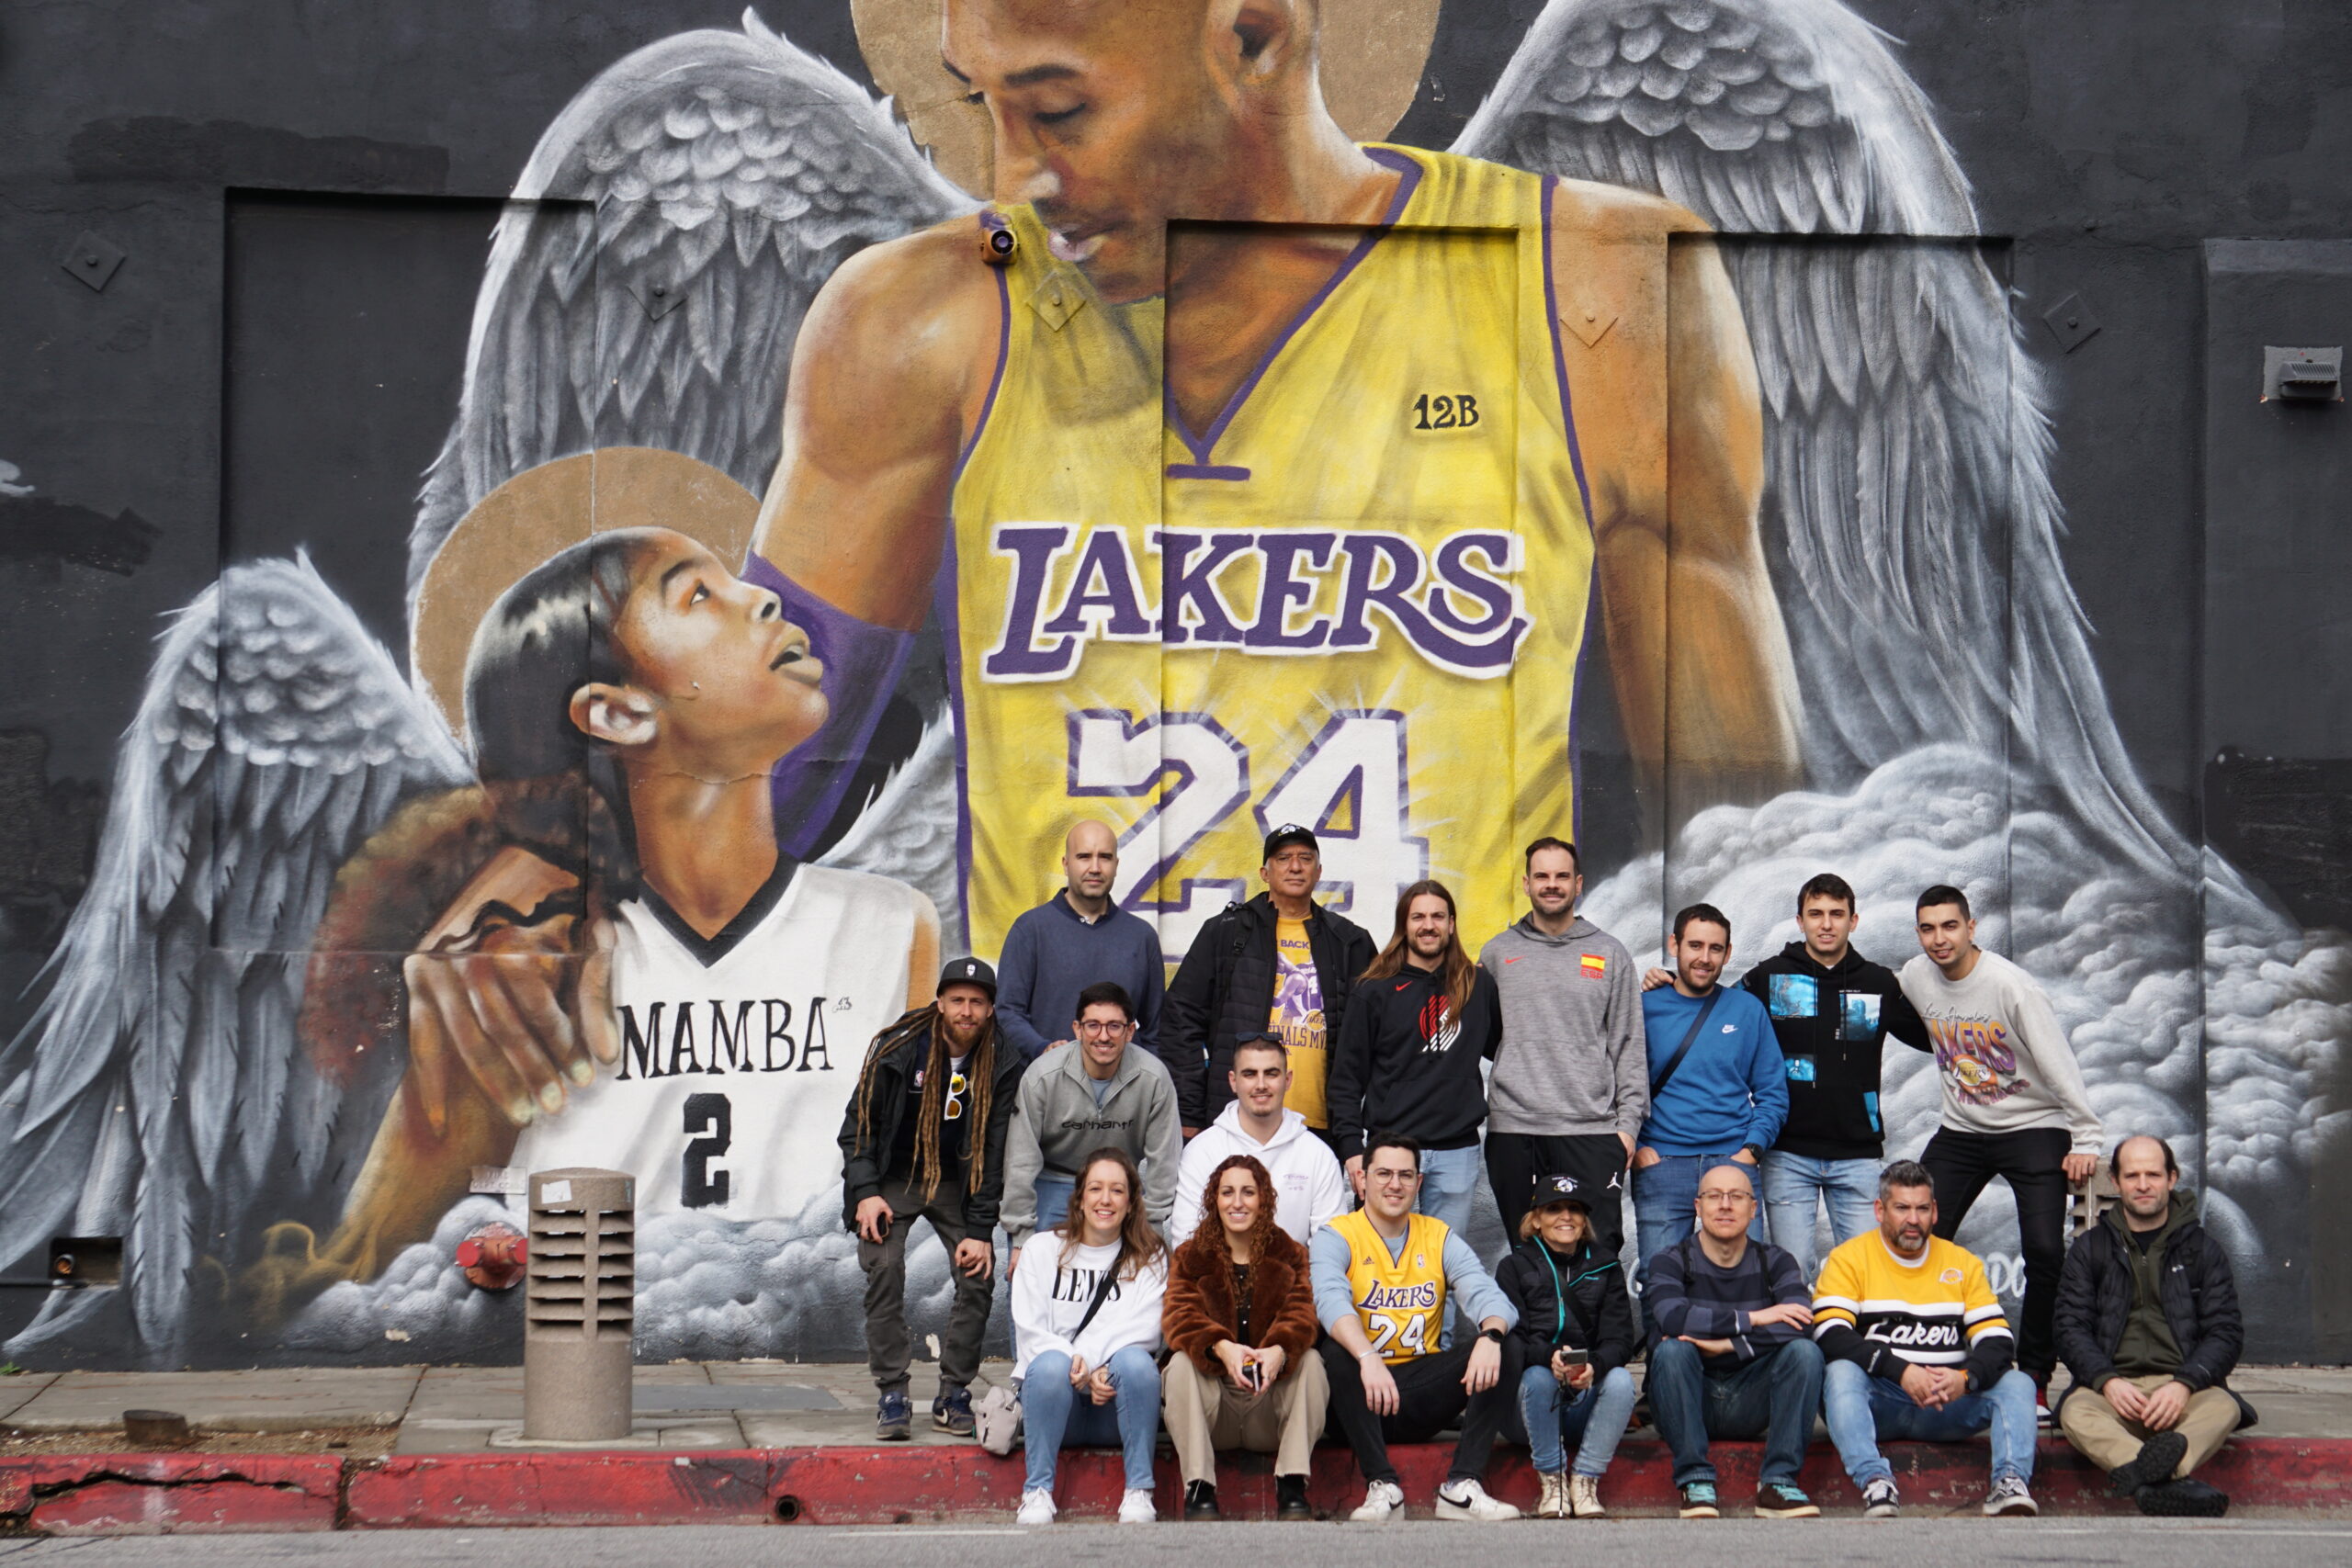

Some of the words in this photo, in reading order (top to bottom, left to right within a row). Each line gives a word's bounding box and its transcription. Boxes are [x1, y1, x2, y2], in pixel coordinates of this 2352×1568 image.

[1412, 393, 1479, 429] 12B
[982, 522, 1534, 682] LAKERS
[1067, 708, 1430, 961] 24
[1280, 940, 1310, 950] BACK
[1579, 969, 1604, 980] ESP
[616, 997, 834, 1080] MAMBA
[680, 1092, 731, 1209] 2
[1357, 1279, 1437, 1311] LAKERS
[1368, 1313, 1427, 1358] 24
[1864, 1318, 1960, 1346] Lakers
